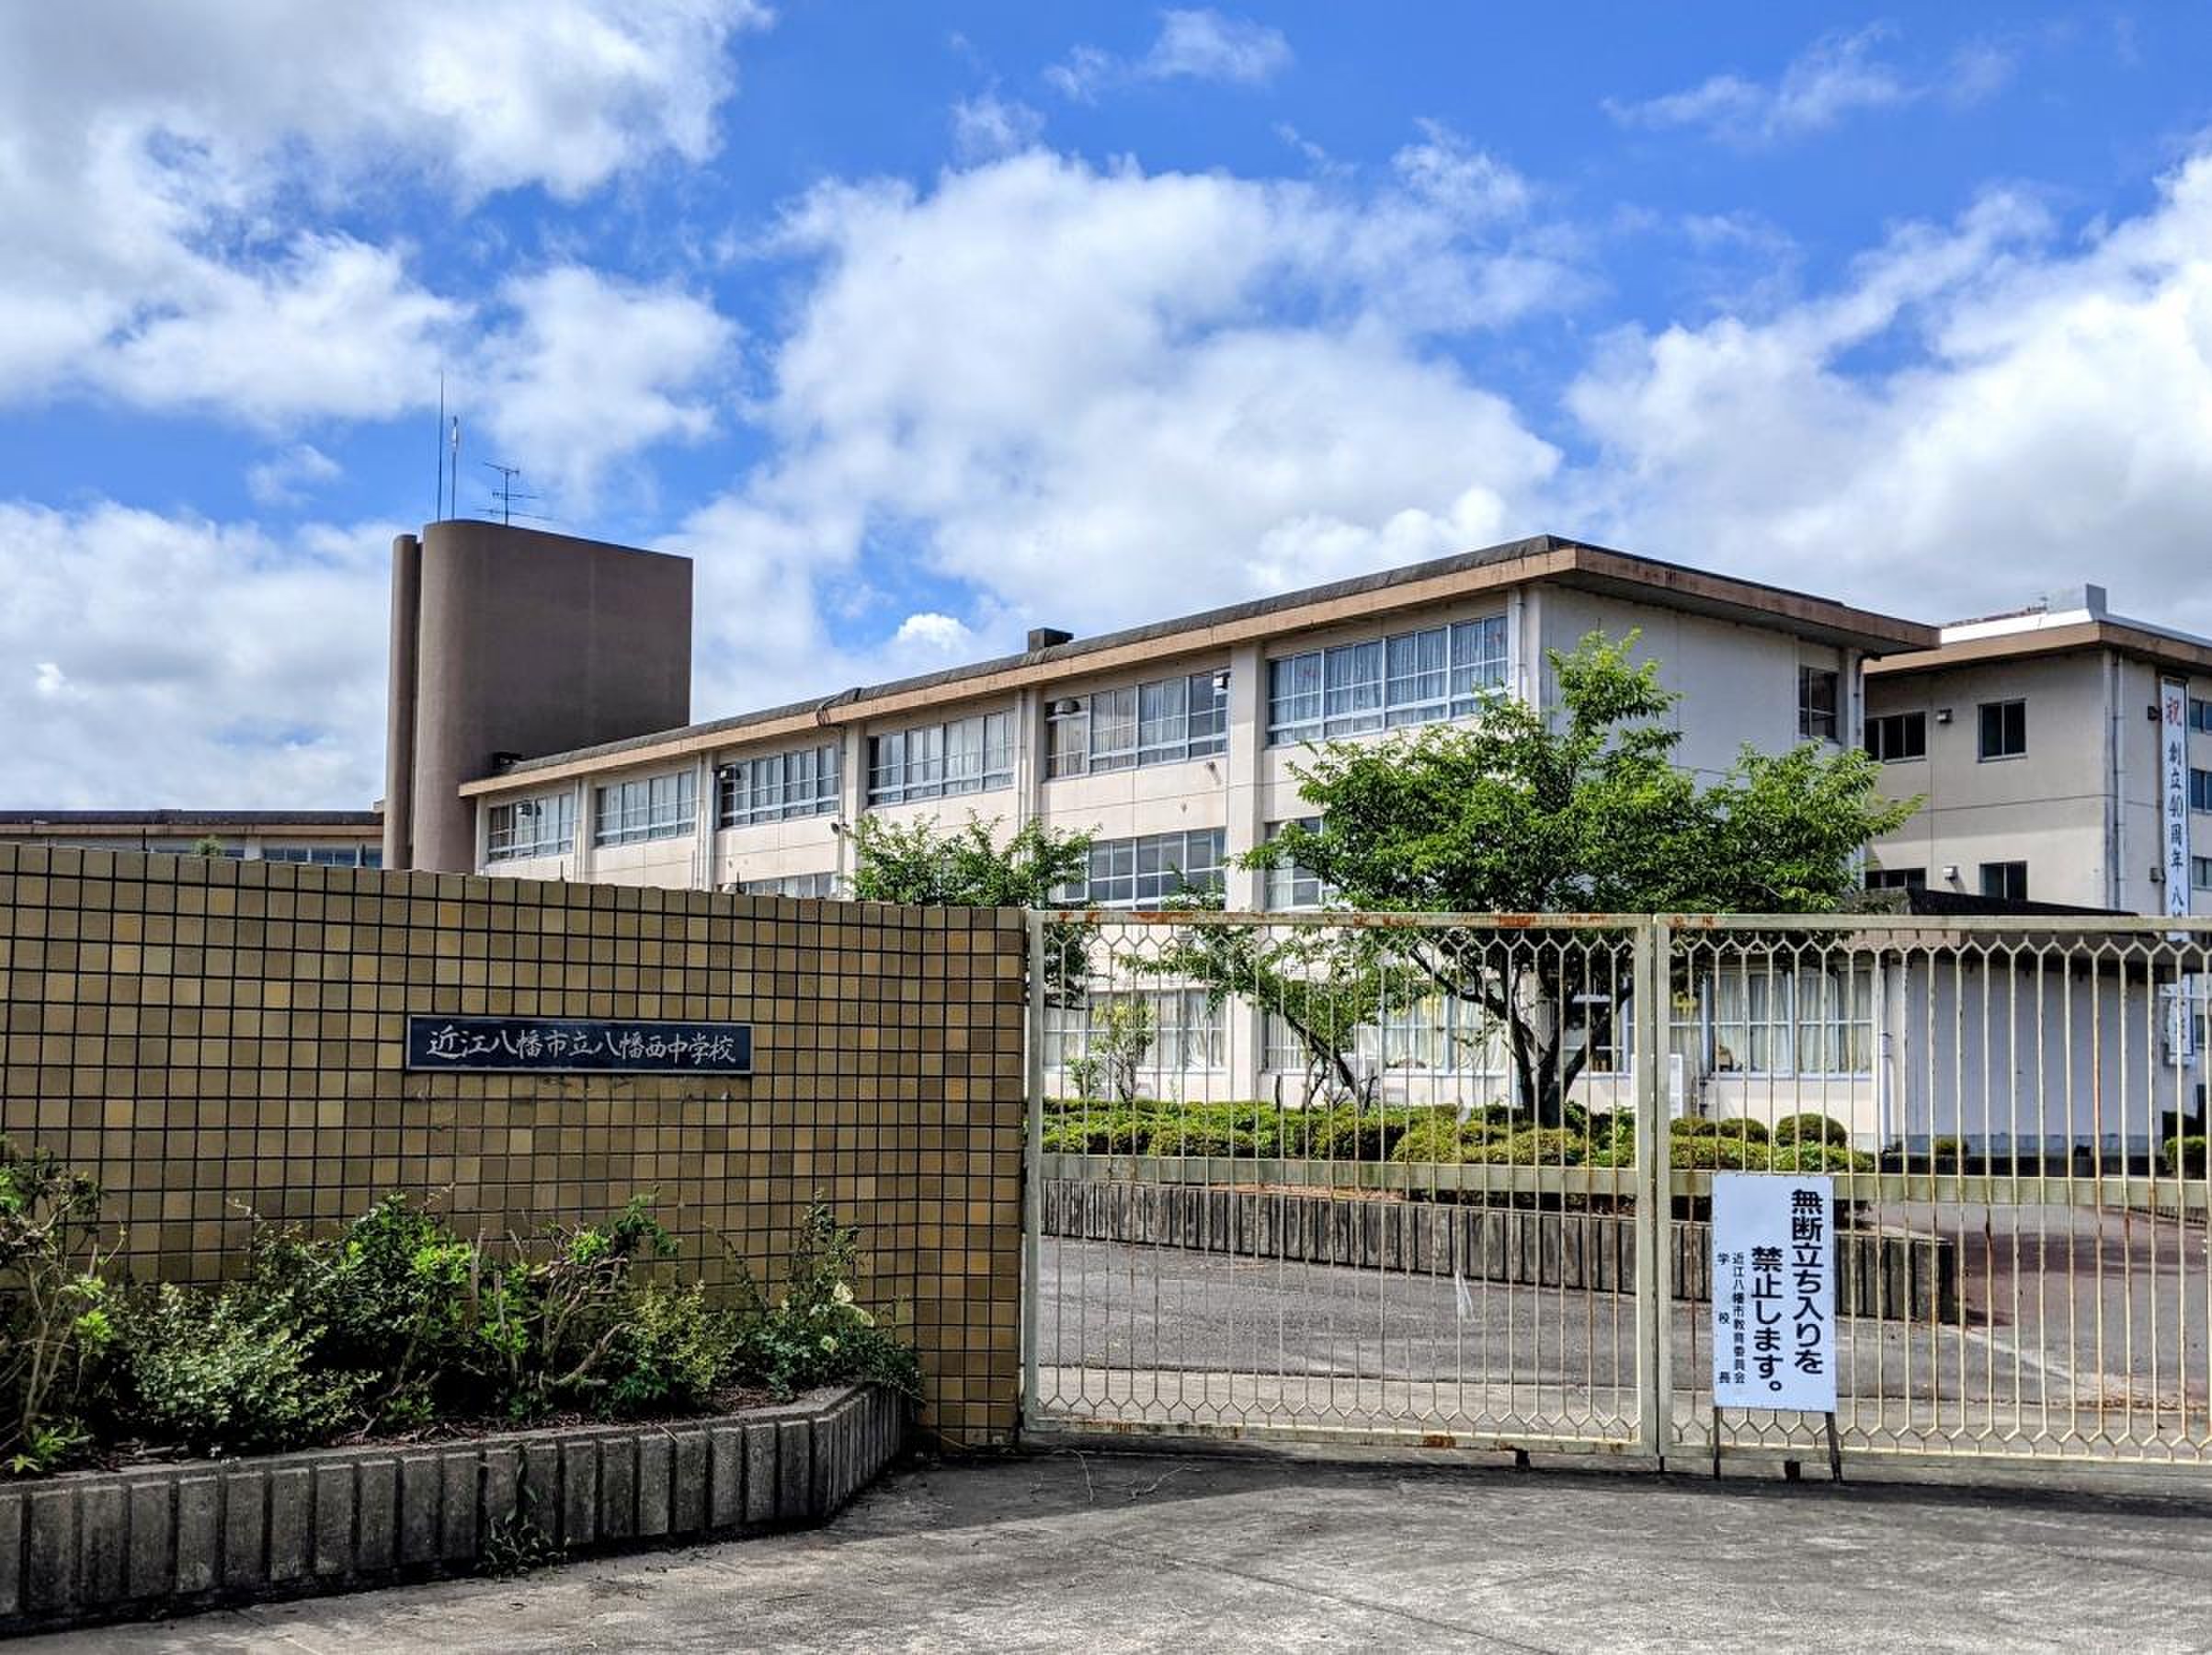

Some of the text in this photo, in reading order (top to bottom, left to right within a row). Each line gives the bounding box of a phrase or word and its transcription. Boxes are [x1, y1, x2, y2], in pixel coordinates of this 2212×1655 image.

[426, 1024, 736, 1065] 近江八幡市立八幡西中学校
[1750, 1246, 1784, 1392] 禁止します。
[1791, 1189, 1825, 1375] 無断立ち入りを
